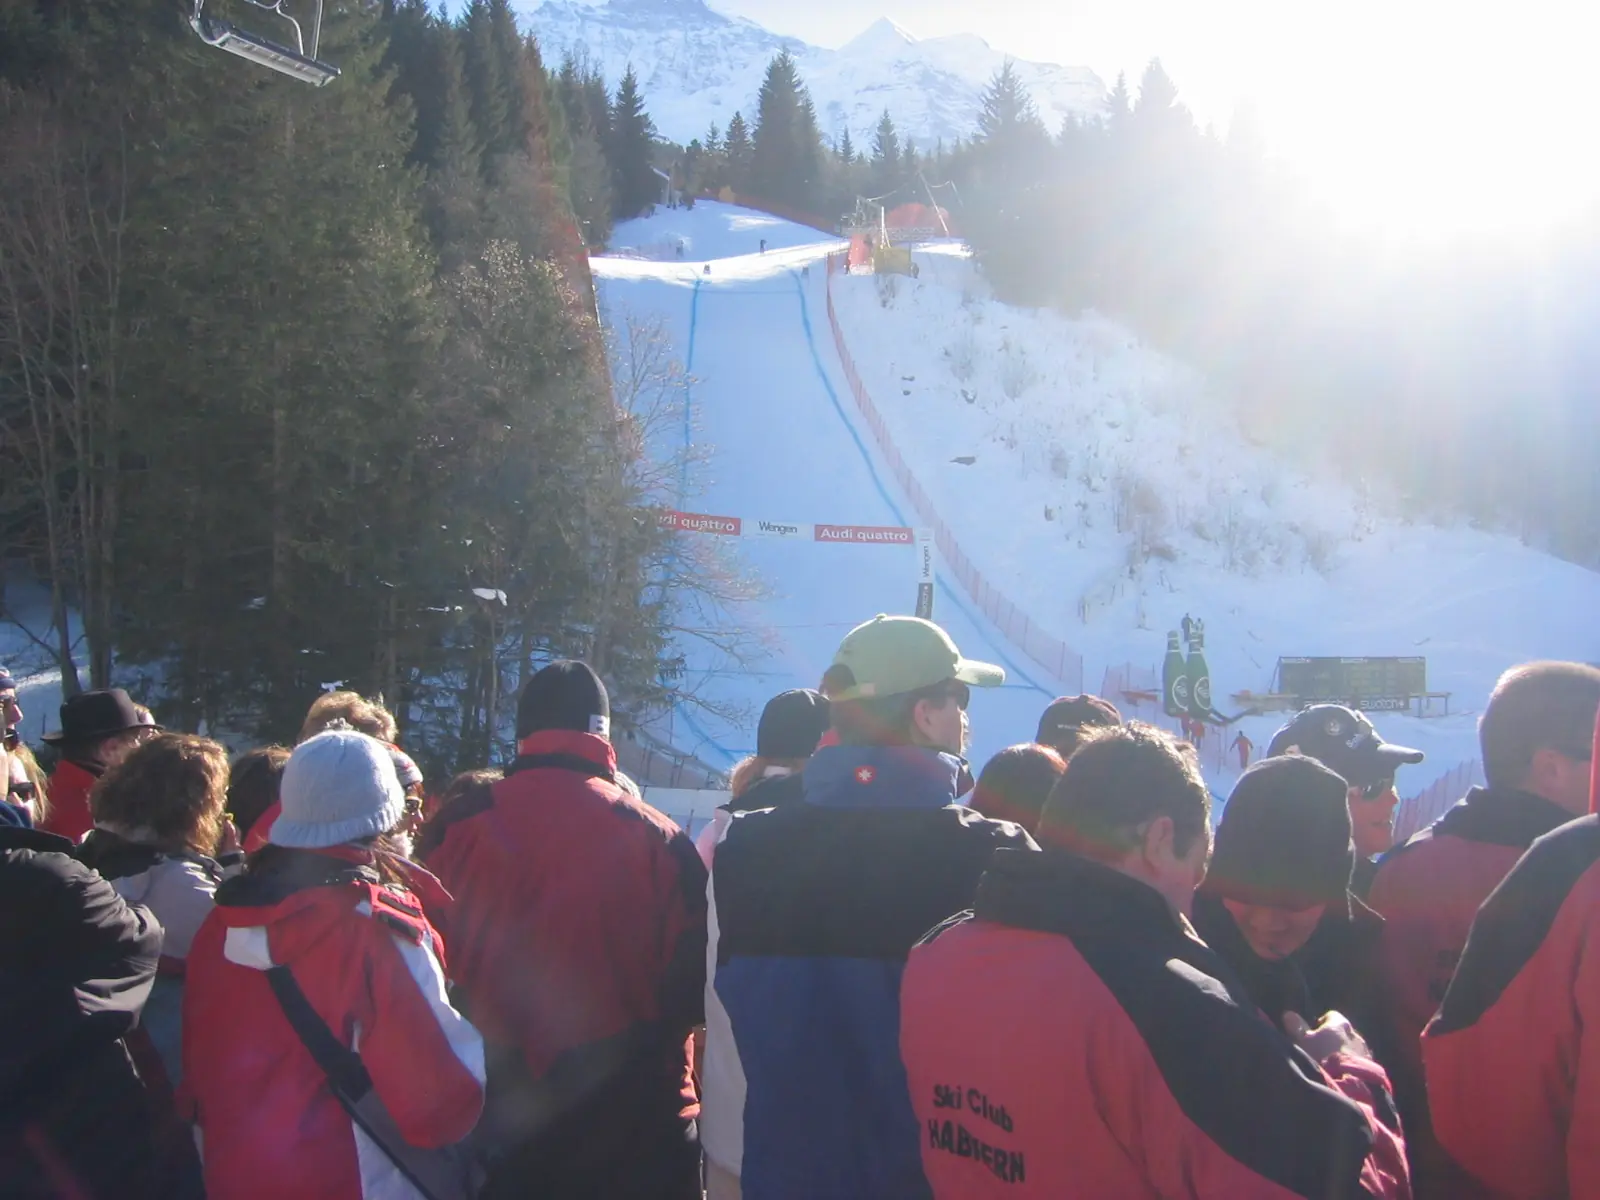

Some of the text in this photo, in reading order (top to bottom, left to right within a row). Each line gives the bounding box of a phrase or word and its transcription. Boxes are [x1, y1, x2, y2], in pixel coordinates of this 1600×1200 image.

[681, 517, 735, 532] quattro
[758, 520, 798, 535] Wengen
[820, 528, 909, 543] Audi quattro
[933, 1084, 1014, 1133] Ski Club
